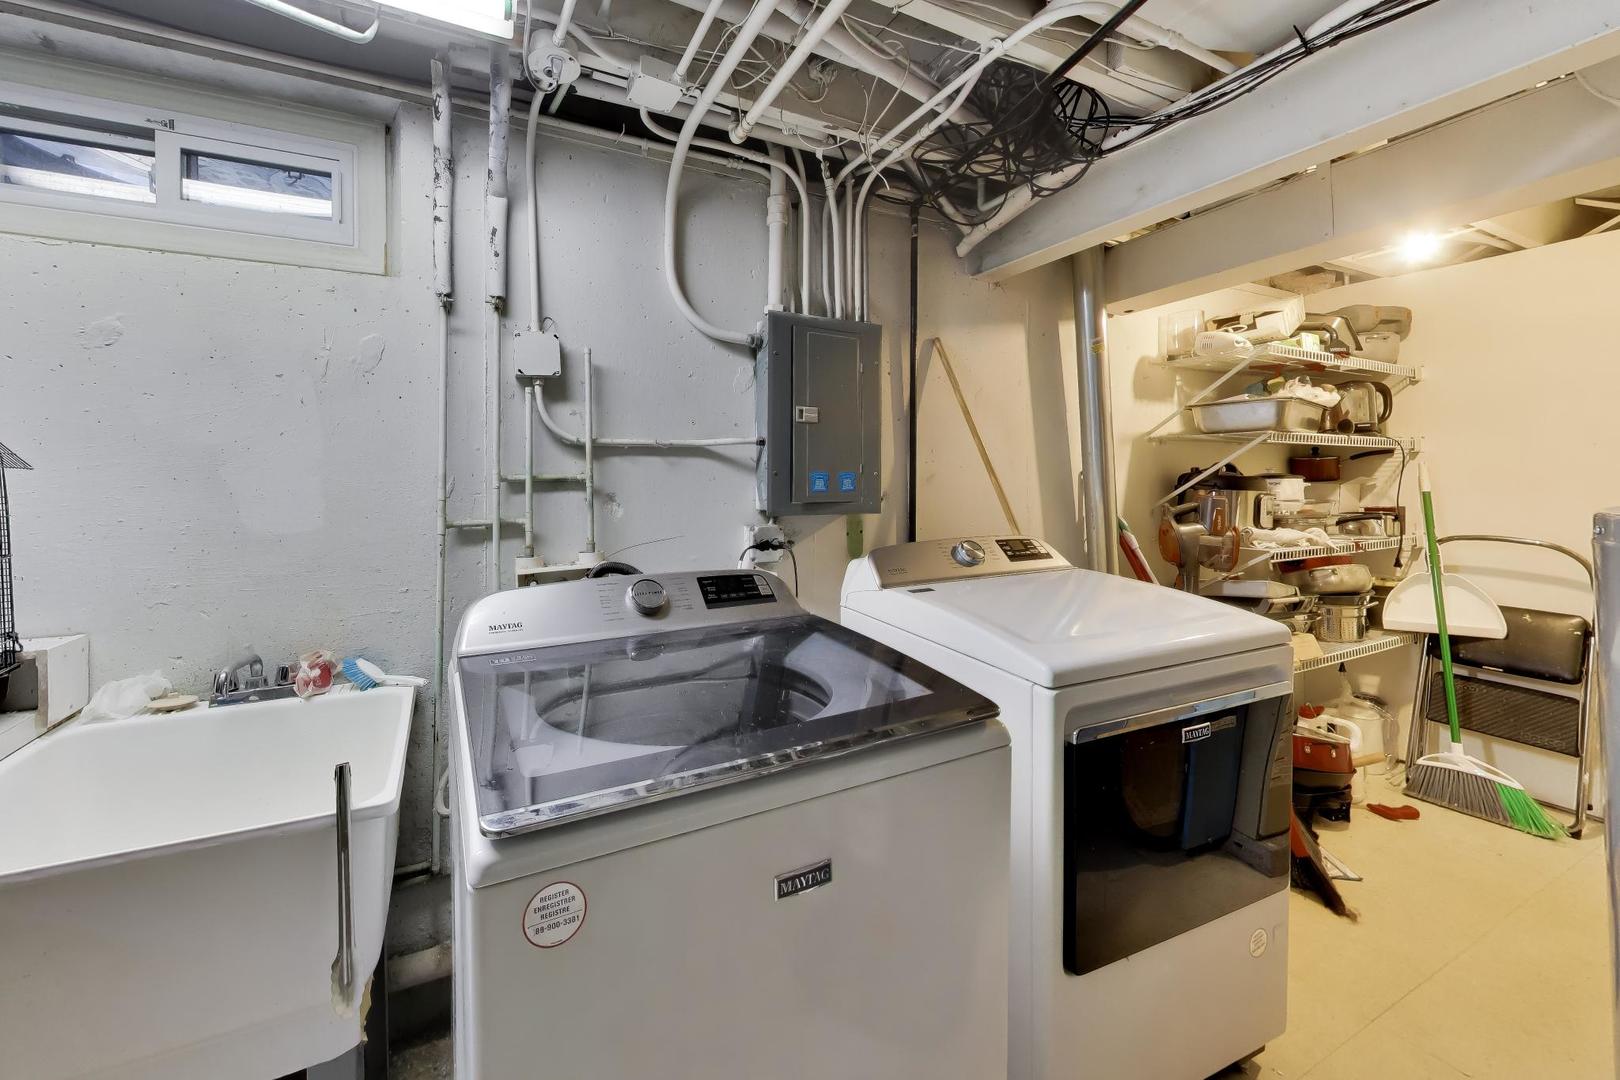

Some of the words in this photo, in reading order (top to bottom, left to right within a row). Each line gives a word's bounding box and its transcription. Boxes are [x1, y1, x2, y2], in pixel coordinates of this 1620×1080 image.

[488, 621, 523, 632] MAYTAG
[1186, 727, 1209, 740] MAYTAG
[780, 868, 830, 895] MAYTAG
[539, 889, 570, 904] REGISTER
[533, 895, 577, 914] ENREGISTRER
[540, 906, 570, 921] REGISTRE
